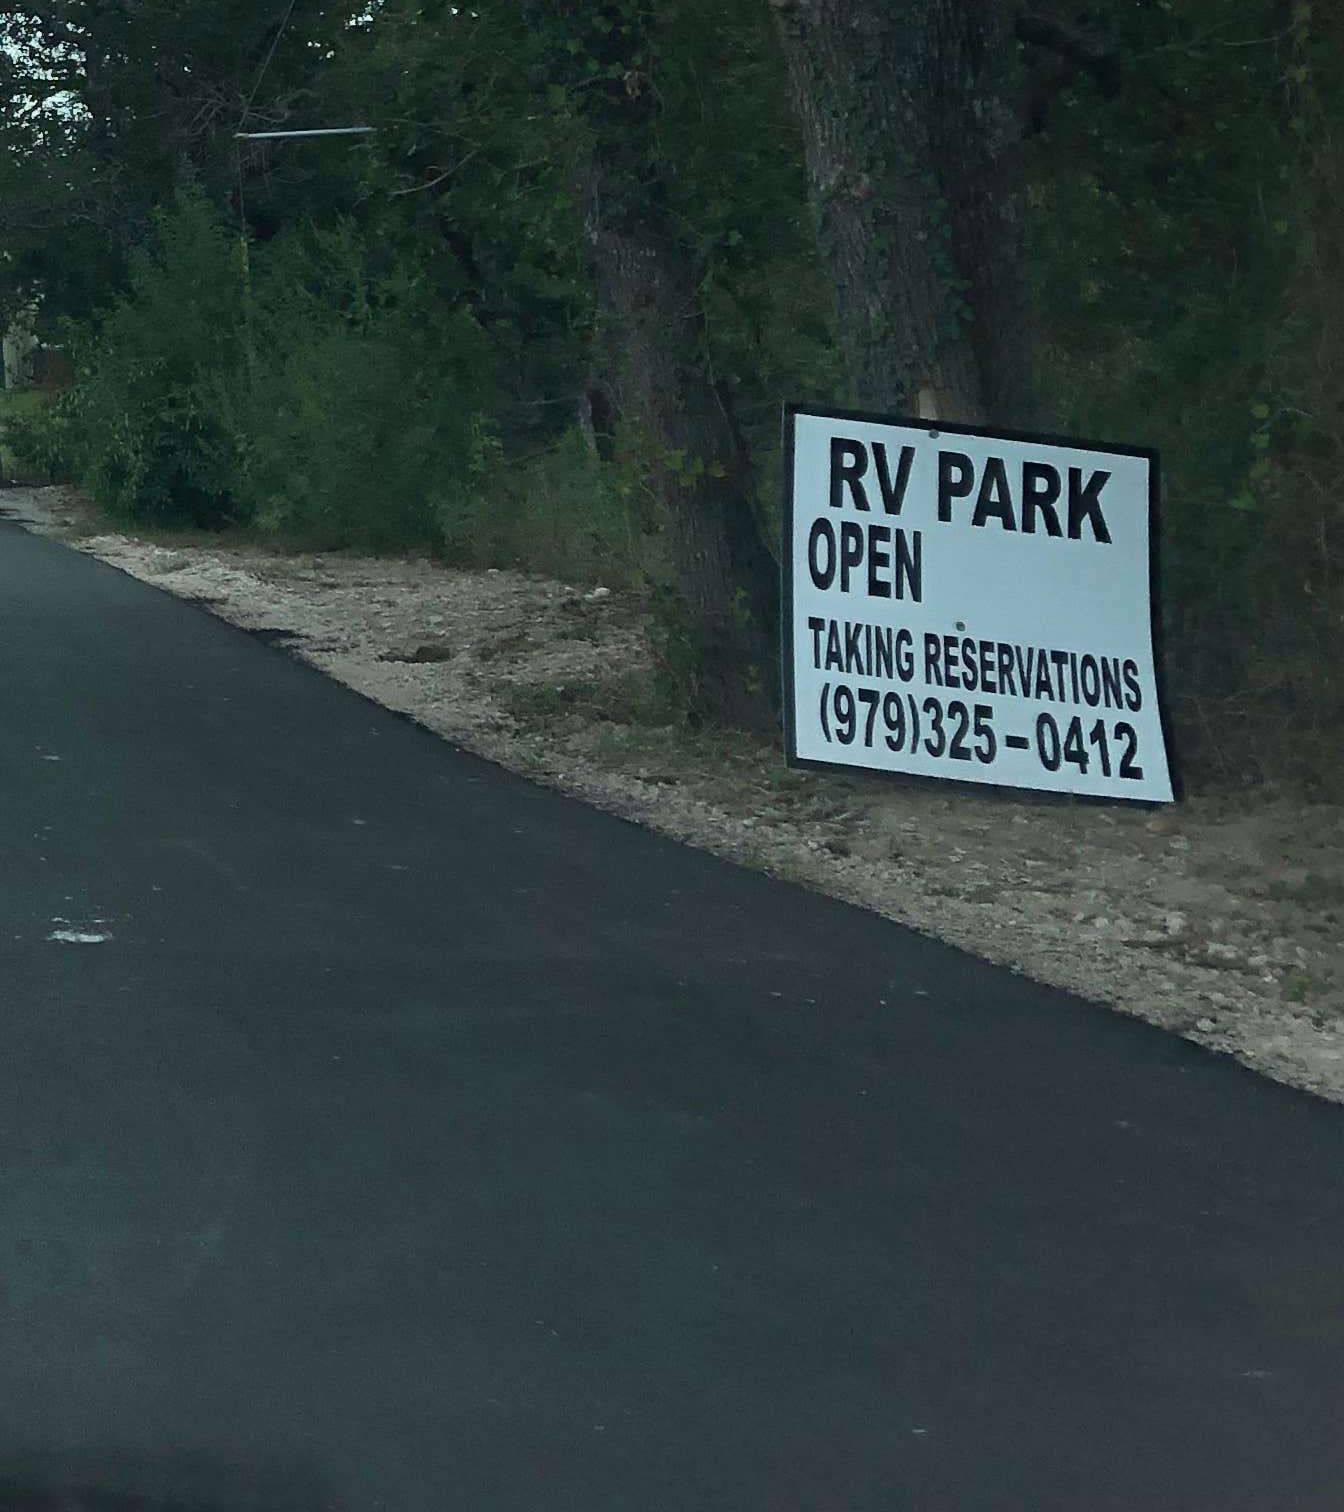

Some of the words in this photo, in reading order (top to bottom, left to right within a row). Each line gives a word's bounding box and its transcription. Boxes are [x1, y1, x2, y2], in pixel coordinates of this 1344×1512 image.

[829, 437, 916, 516] RV
[937, 450, 1113, 545] PARK
[808, 517, 923, 603] OPEN
[808, 616, 914, 683] TAKING
[924, 632, 1143, 713] RESERVATIONS
[820, 682, 1144, 780] (979)325-0412
